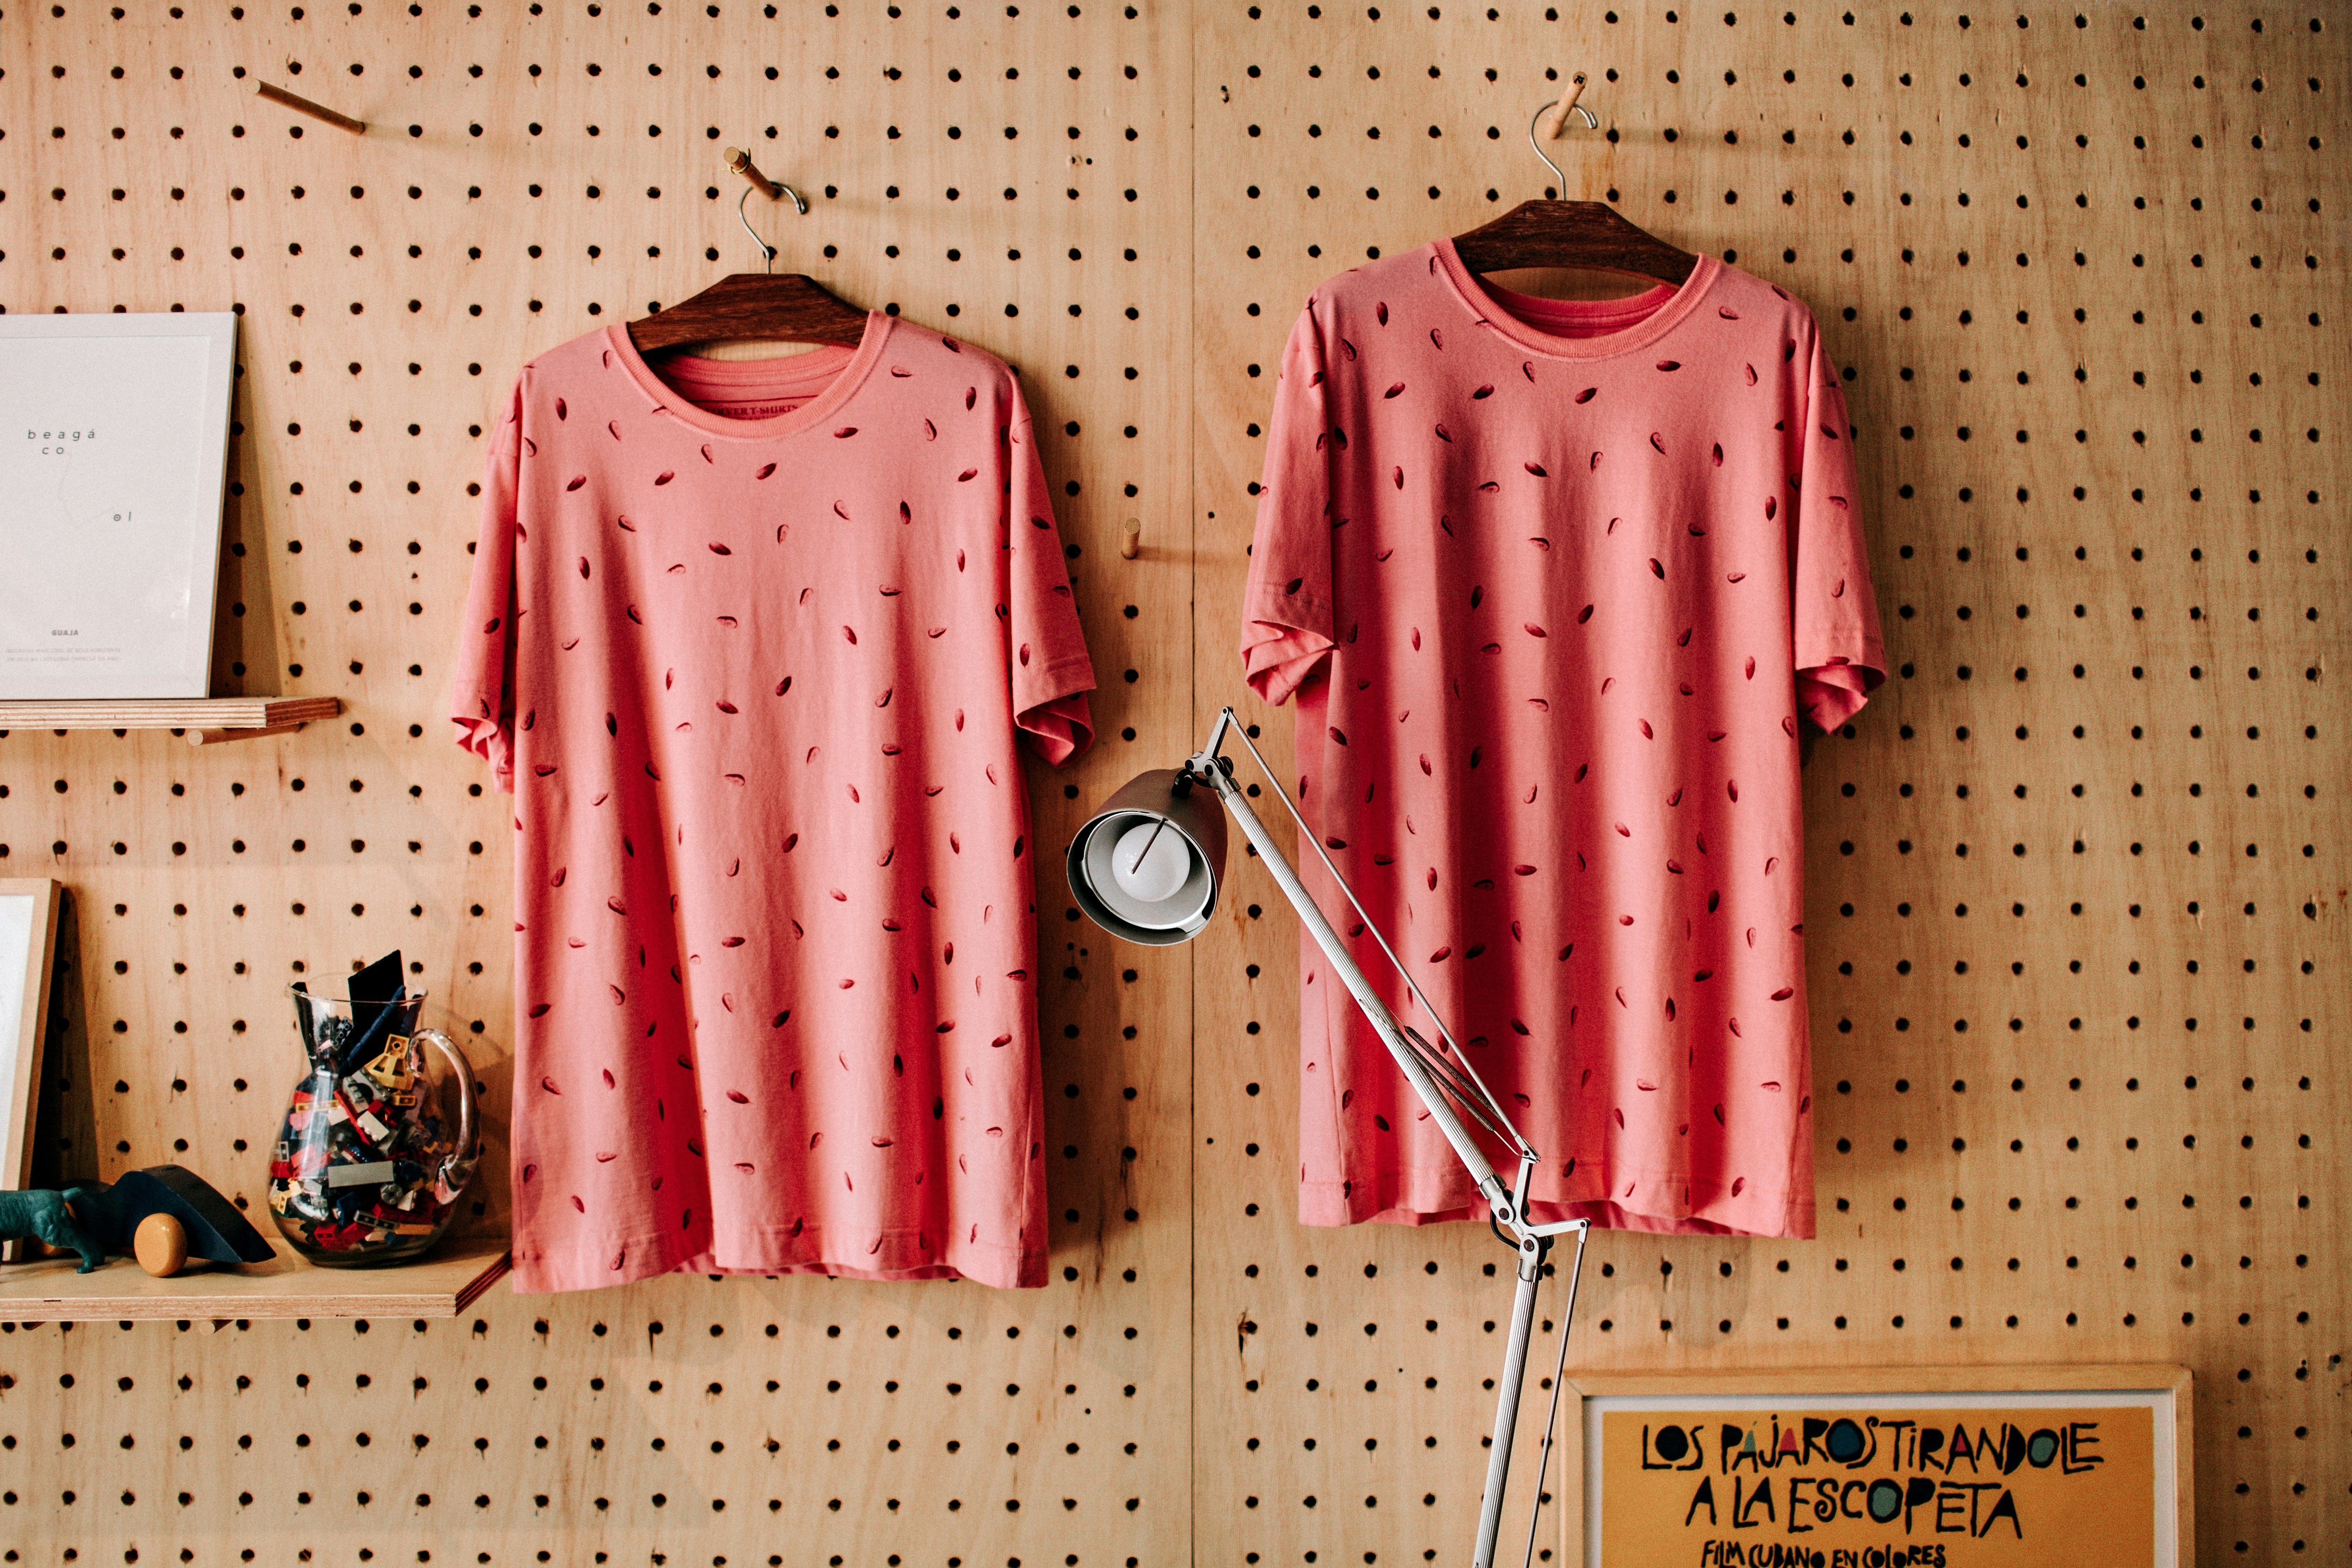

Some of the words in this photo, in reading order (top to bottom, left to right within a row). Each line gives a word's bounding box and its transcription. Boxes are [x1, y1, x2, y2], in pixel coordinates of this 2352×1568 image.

[28, 429, 95, 442] beagá
[1642, 1424, 1704, 1471] LOS
[1685, 1475, 1717, 1527] A
[1733, 1475, 1776, 1529] LA
[1787, 1477, 2023, 1539] ESCOPETA
[1701, 1540, 1746, 1568] FILM
[1749, 1543, 1826, 1568] CUBANO
[1831, 1549, 1858, 1568] EN
[1862, 1543, 1946, 1568] COLORES
